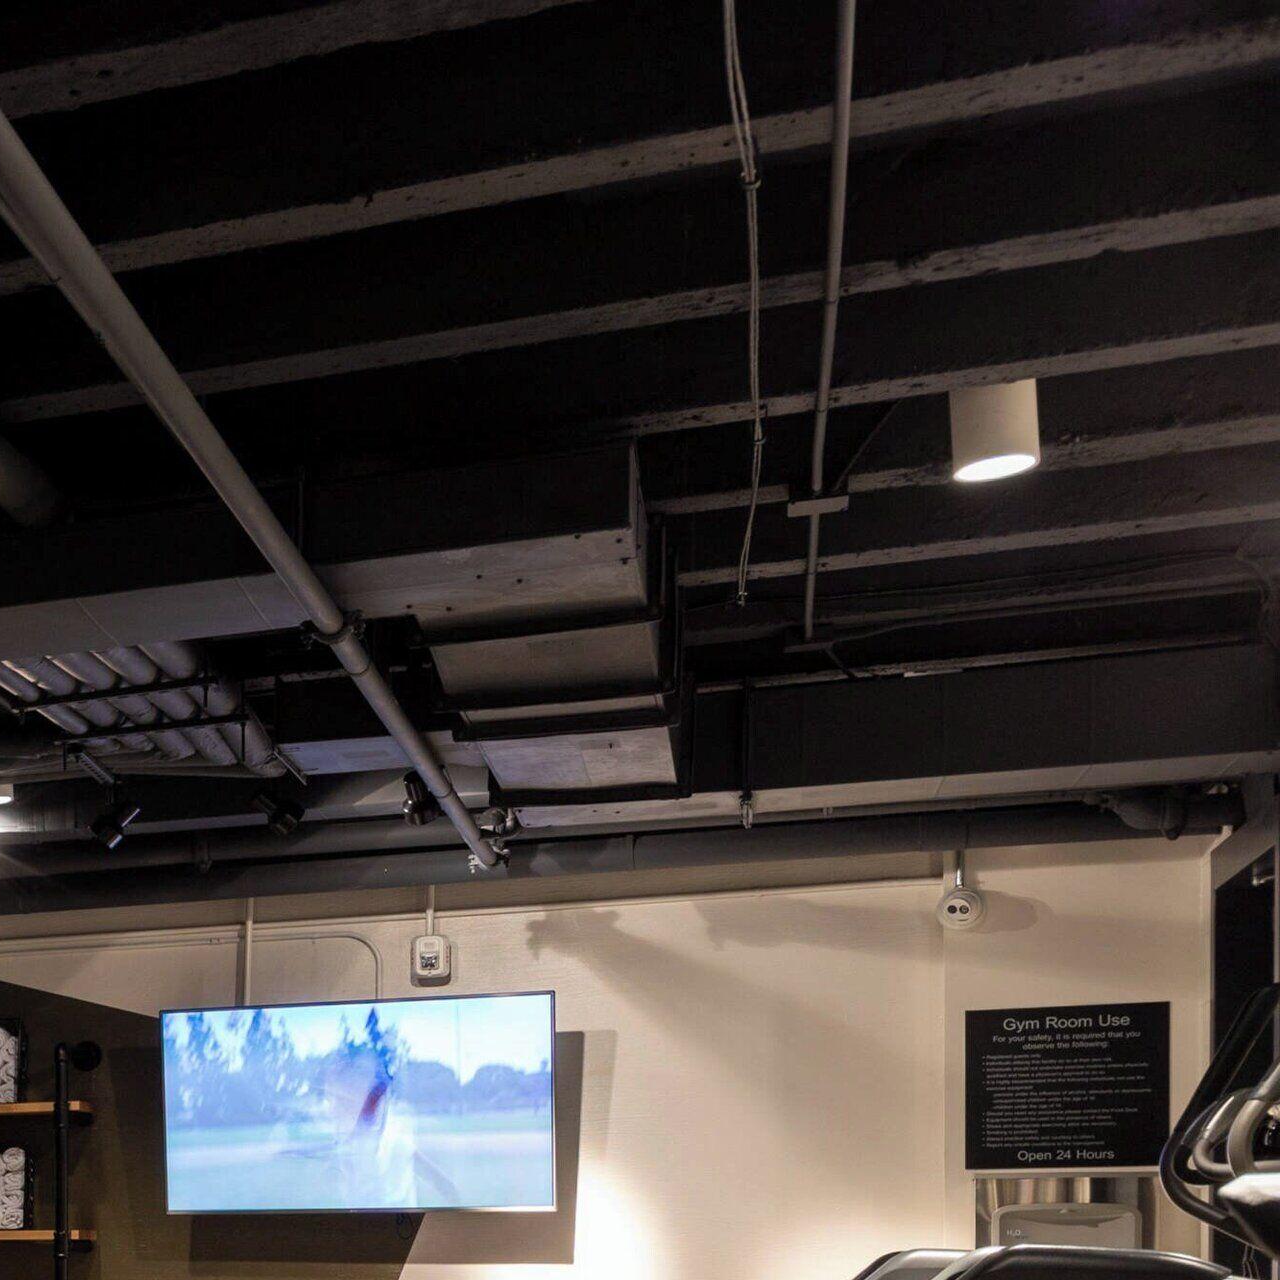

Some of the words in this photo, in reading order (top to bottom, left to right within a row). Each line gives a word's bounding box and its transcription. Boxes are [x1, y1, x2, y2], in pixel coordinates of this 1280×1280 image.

[1002, 1017, 1040, 1034] Gym
[1045, 1016, 1092, 1029] Room
[1098, 1014, 1131, 1027] Use
[992, 1035, 1006, 1043] For
[1008, 1035, 1025, 1044] your
[1028, 1033, 1053, 1043] safety,
[1072, 1031, 1106, 1041] required
[1125, 1031, 1142, 1039] you
[1022, 1042, 1055, 1051] observe
[1056, 1041, 1070, 1049] the
[1071, 1040, 1110, 1050] following:
[1017, 1150, 1052, 1163] Open
[1056, 1150, 1072, 1160] 24
[1076, 1149, 1115, 1160] Hours
